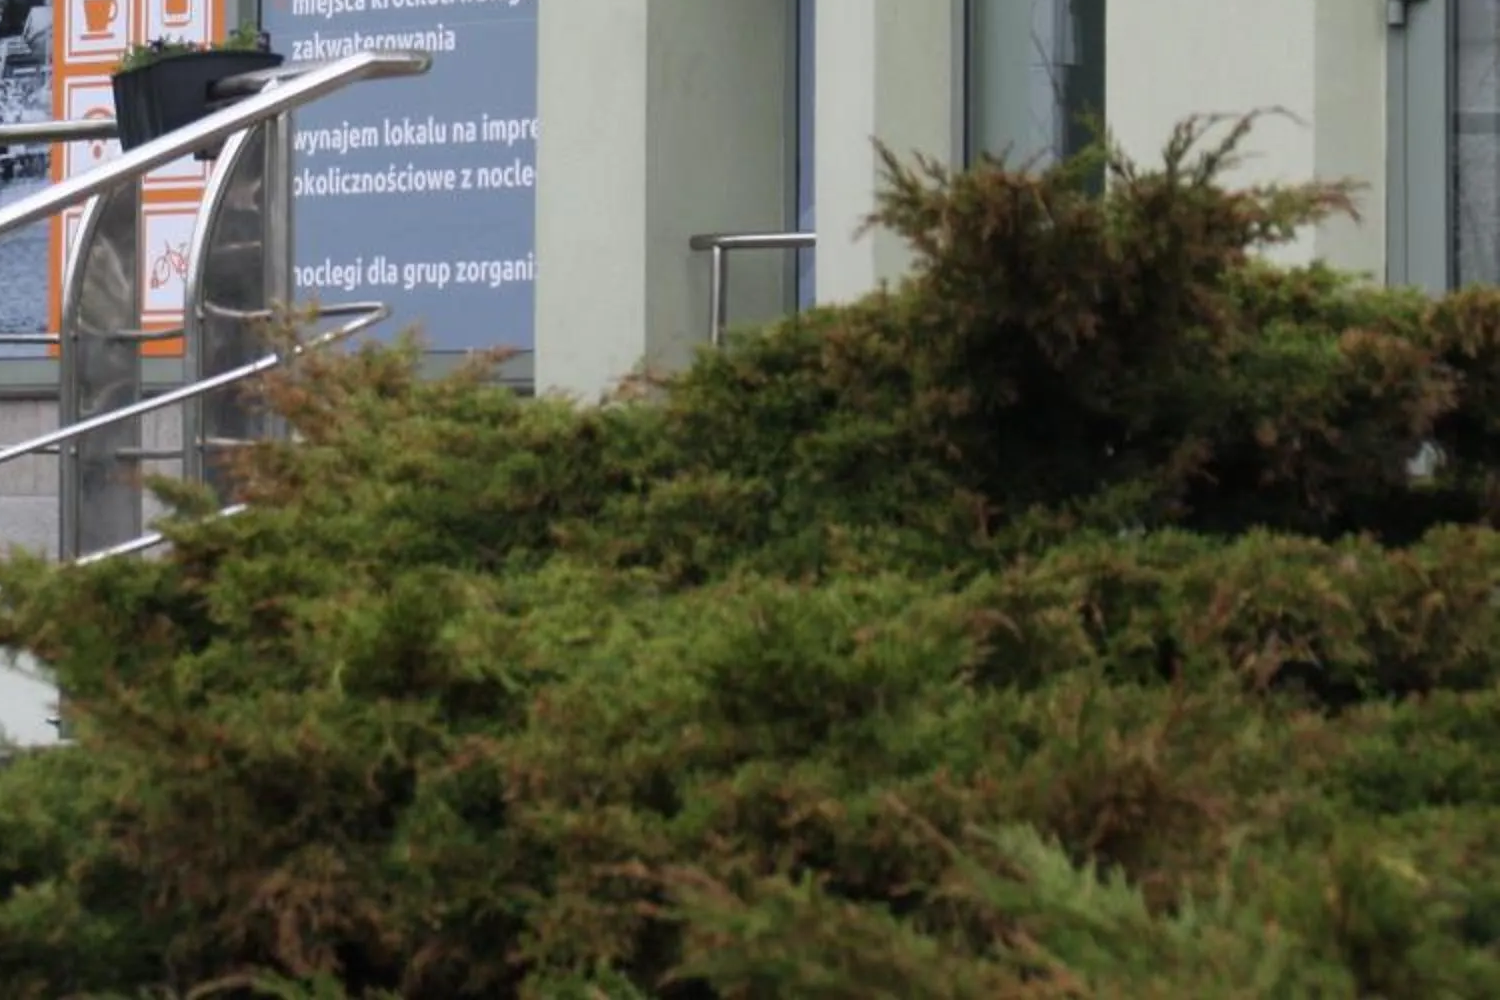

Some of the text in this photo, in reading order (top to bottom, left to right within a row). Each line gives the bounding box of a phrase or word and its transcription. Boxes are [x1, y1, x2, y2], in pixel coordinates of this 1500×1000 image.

[292, 22, 457, 61] zakwaterowania
[293, 121, 379, 156] wynajem
[384, 116, 448, 147] lokalu
[452, 122, 478, 143] na
[292, 157, 540, 197] okolicznościowe z nocle
[367, 256, 398, 286] dla
[403, 262, 451, 291] grup
